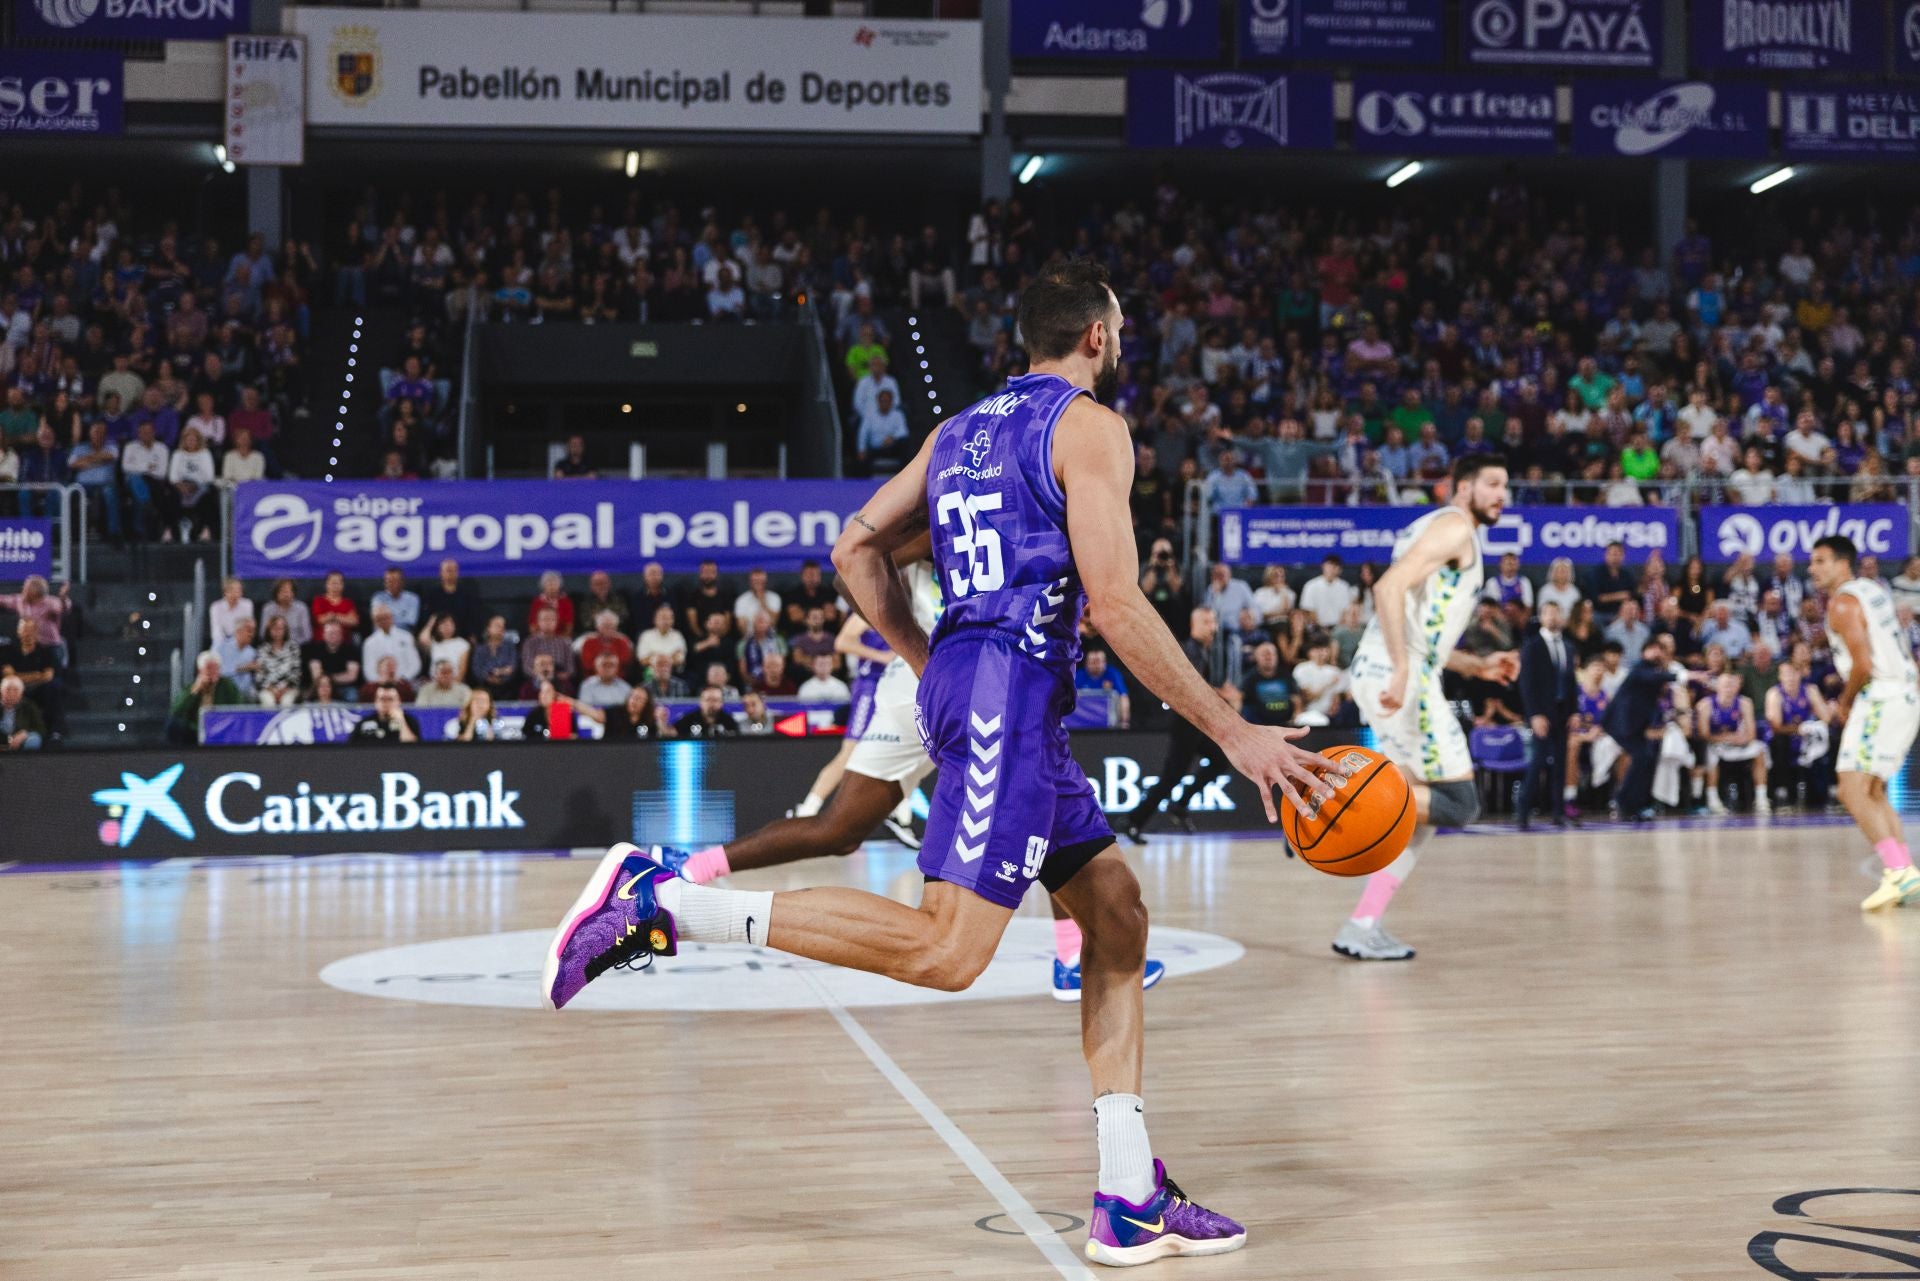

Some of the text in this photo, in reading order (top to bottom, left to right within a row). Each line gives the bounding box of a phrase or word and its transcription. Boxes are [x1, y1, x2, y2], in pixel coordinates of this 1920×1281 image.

[1043, 22, 1148, 51] Adarsa
[1523, 0, 1652, 50] PAYÁ
[1723, 0, 1851, 52] BROOKLYN
[232, 40, 298, 61] RIFA
[418, 64, 952, 110] Pabellón Municipal de Deportes
[1430, 89, 1552, 119] ortega
[333, 493, 422, 518] súper
[334, 501, 614, 562] agropal
[936, 491, 1004, 597] 35
[1540, 516, 1667, 548] cofersa
[1768, 507, 1893, 553] ovlac
[205, 771, 523, 834] CaixaBank
